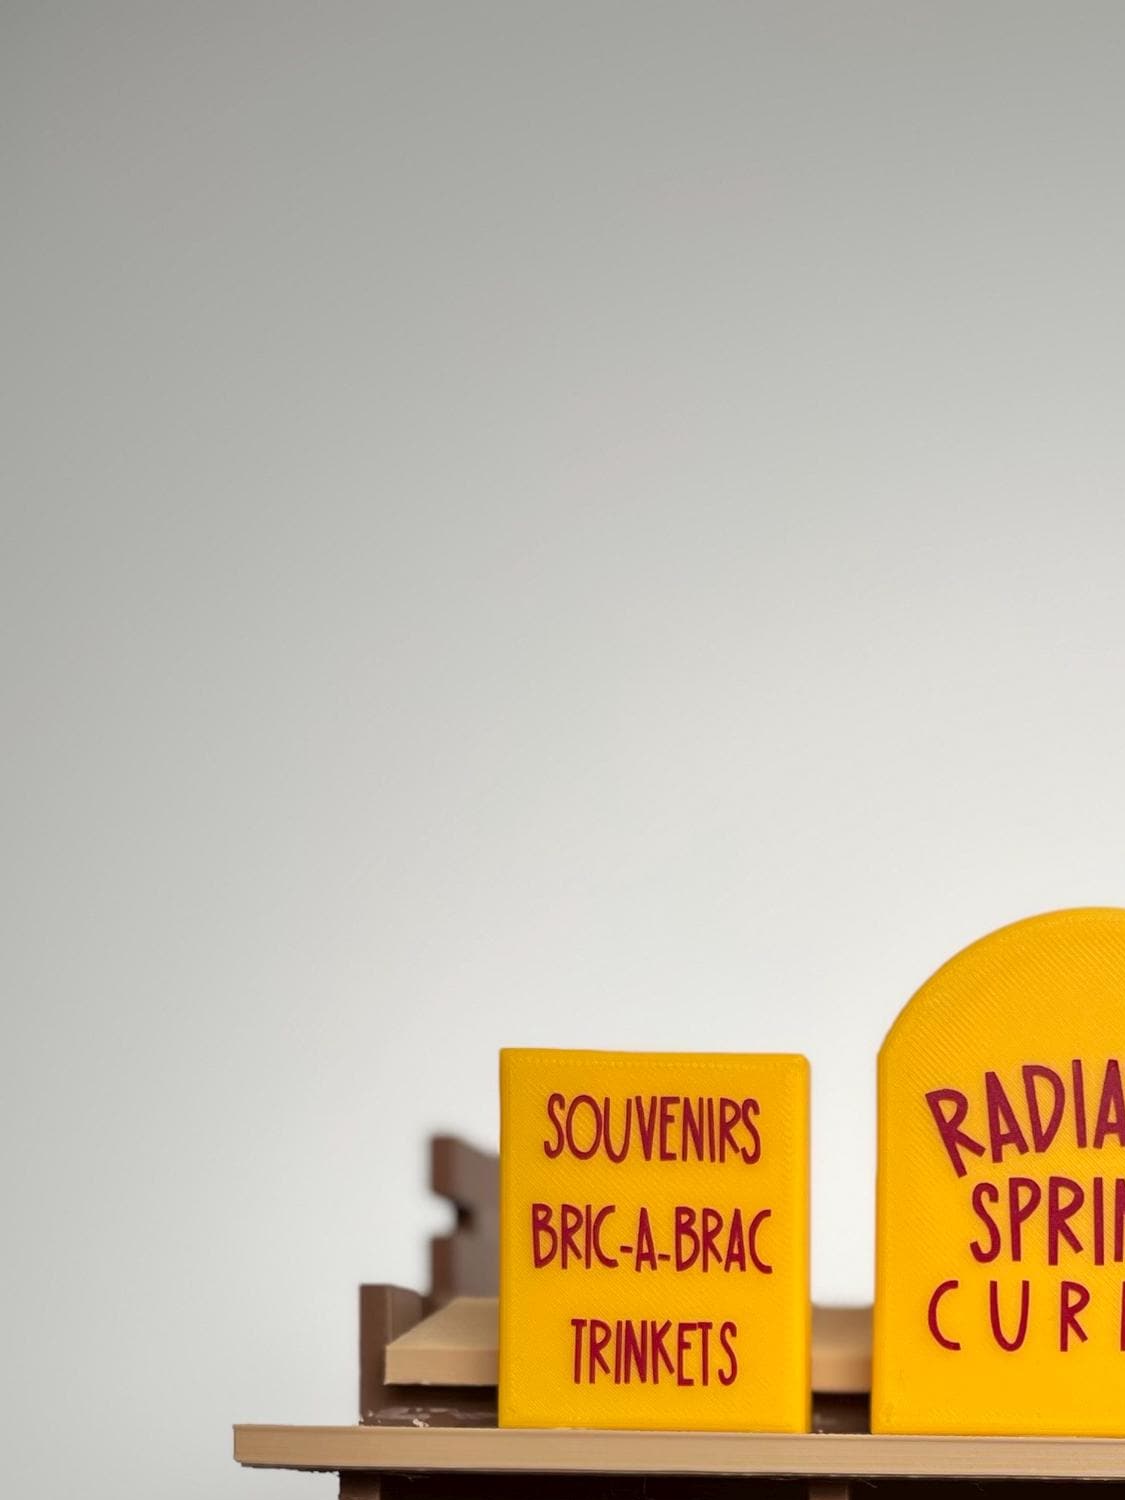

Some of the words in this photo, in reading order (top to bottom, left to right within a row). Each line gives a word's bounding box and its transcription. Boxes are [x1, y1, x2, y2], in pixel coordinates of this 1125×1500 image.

[543, 1092, 762, 1165] SOUVENIRS
[531, 1202, 774, 1275] BRIC-A-BRAC
[570, 1318, 739, 1388] TRINKETS
